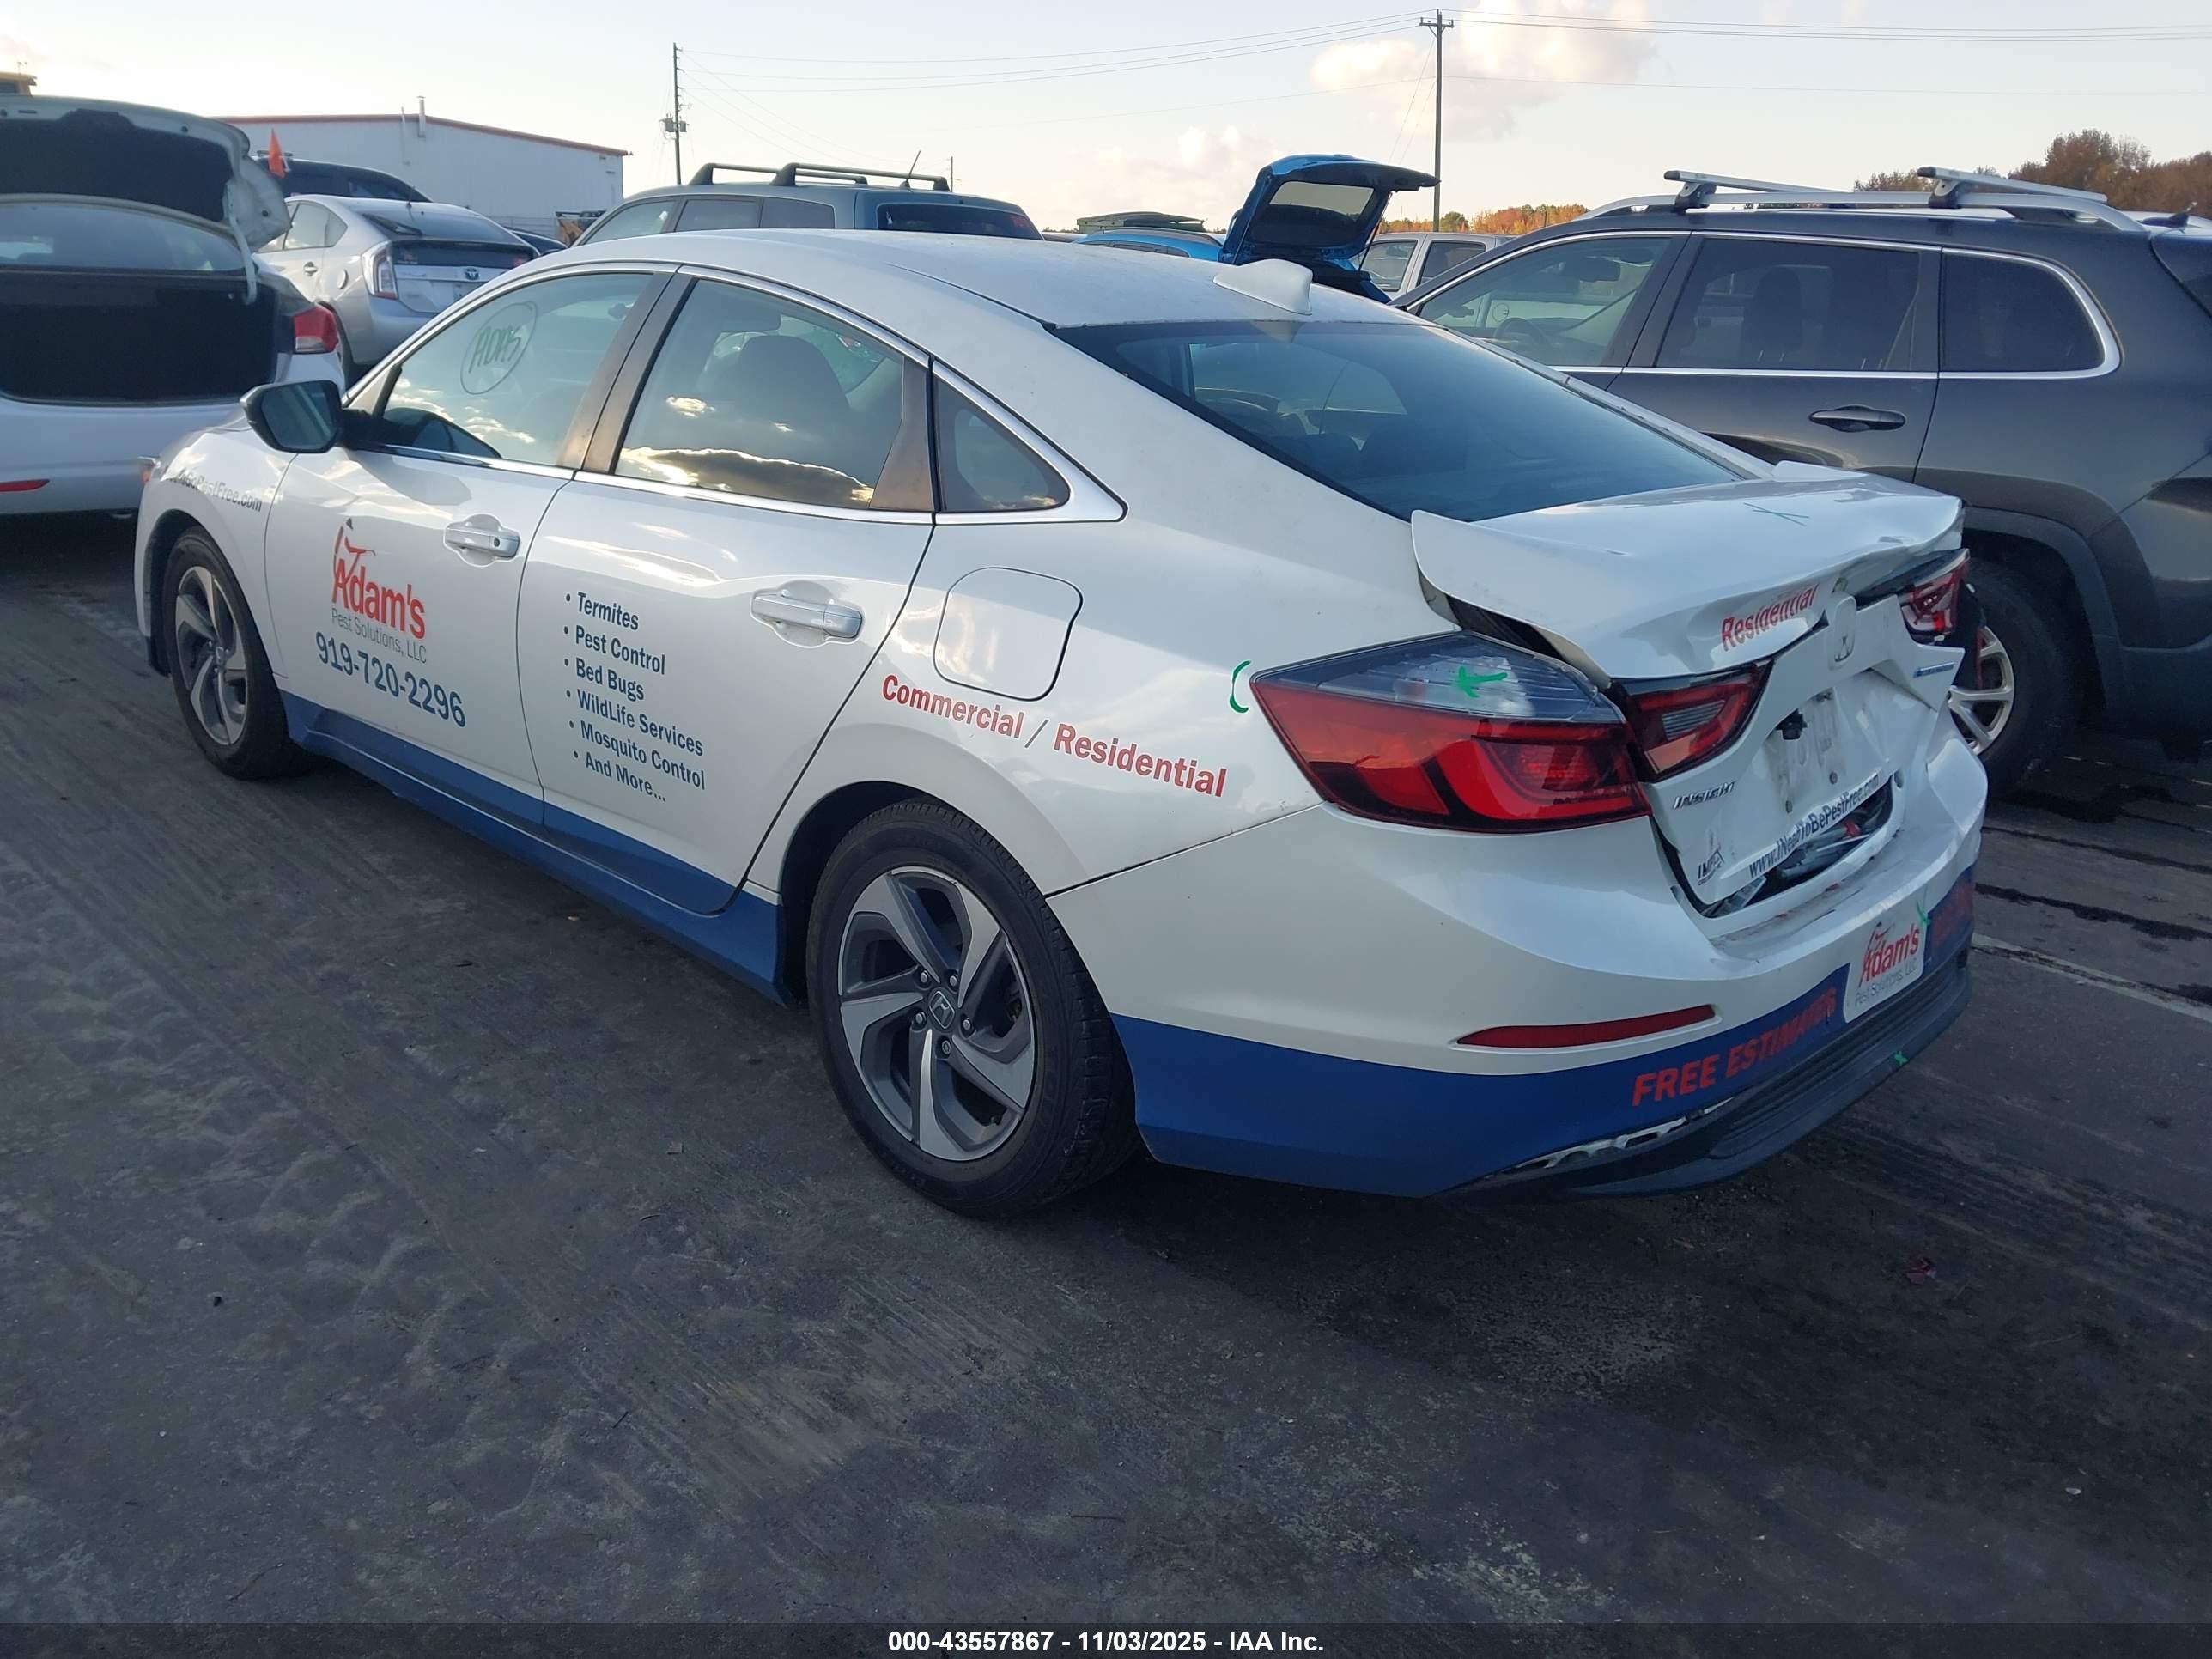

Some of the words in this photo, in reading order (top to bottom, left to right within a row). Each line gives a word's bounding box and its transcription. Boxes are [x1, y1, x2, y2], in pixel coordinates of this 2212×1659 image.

[331, 556, 426, 640] Adam's
[577, 591, 640, 631] Termites
[1721, 583, 1820, 653] Residential
[331, 606, 353, 634] Pest
[354, 617, 405, 656] Solutions,
[407, 644, 428, 665] LLC
[575, 624, 607, 655] Pest
[611, 637, 666, 676] Control
[315, 630, 467, 728] 919-720-2296
[575, 657, 604, 686] Bed
[607, 668, 645, 702] Bugs
[577, 688, 635, 728] WildLife
[639, 713, 704, 757] Services
[882, 674, 1025, 739] Commercial
[1024, 718, 1050, 749] /
[1054, 723, 1228, 798] Residential
[580, 720, 647, 764] Mosquito
[651, 749, 706, 791] Control
[586, 751, 611, 778] And
[616, 763, 666, 802] More...
[1858, 923, 1920, 988] Adam's
[1632, 1054, 1720, 1107] FREE
